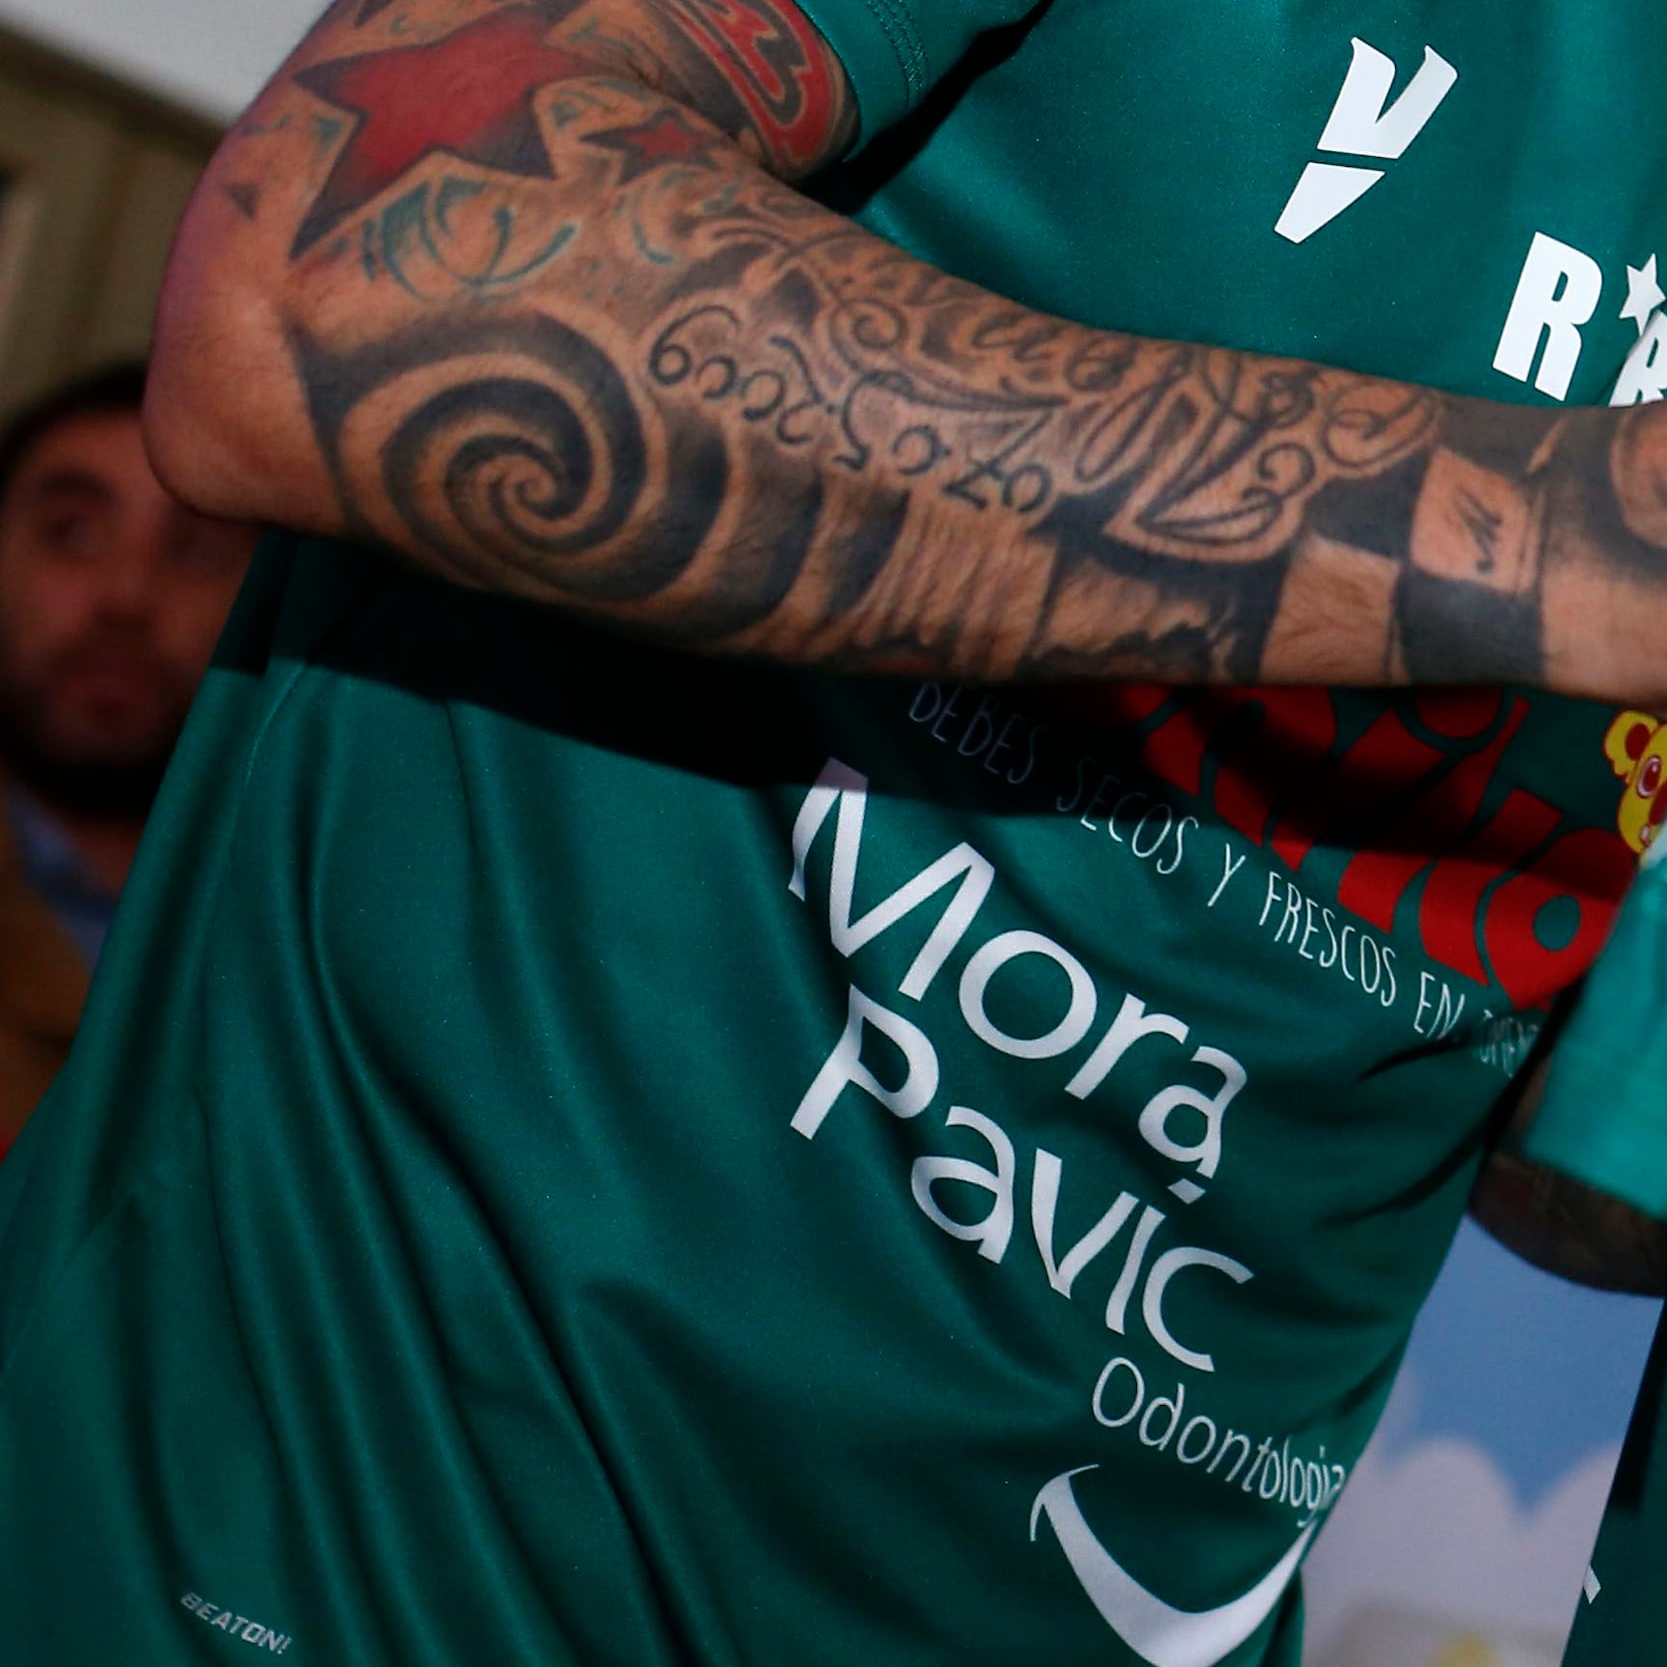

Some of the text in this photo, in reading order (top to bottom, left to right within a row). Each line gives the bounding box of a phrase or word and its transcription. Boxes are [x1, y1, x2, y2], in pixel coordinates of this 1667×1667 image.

[787, 756, 1248, 1181] Mora
[1055, 752, 1200, 875] SECOS
[1207, 841, 1247, 908] Y
[1258, 870, 1400, 1009] FRESCOS
[1412, 970, 1467, 1042] EN
[789, 982, 1255, 1373] Pavic
